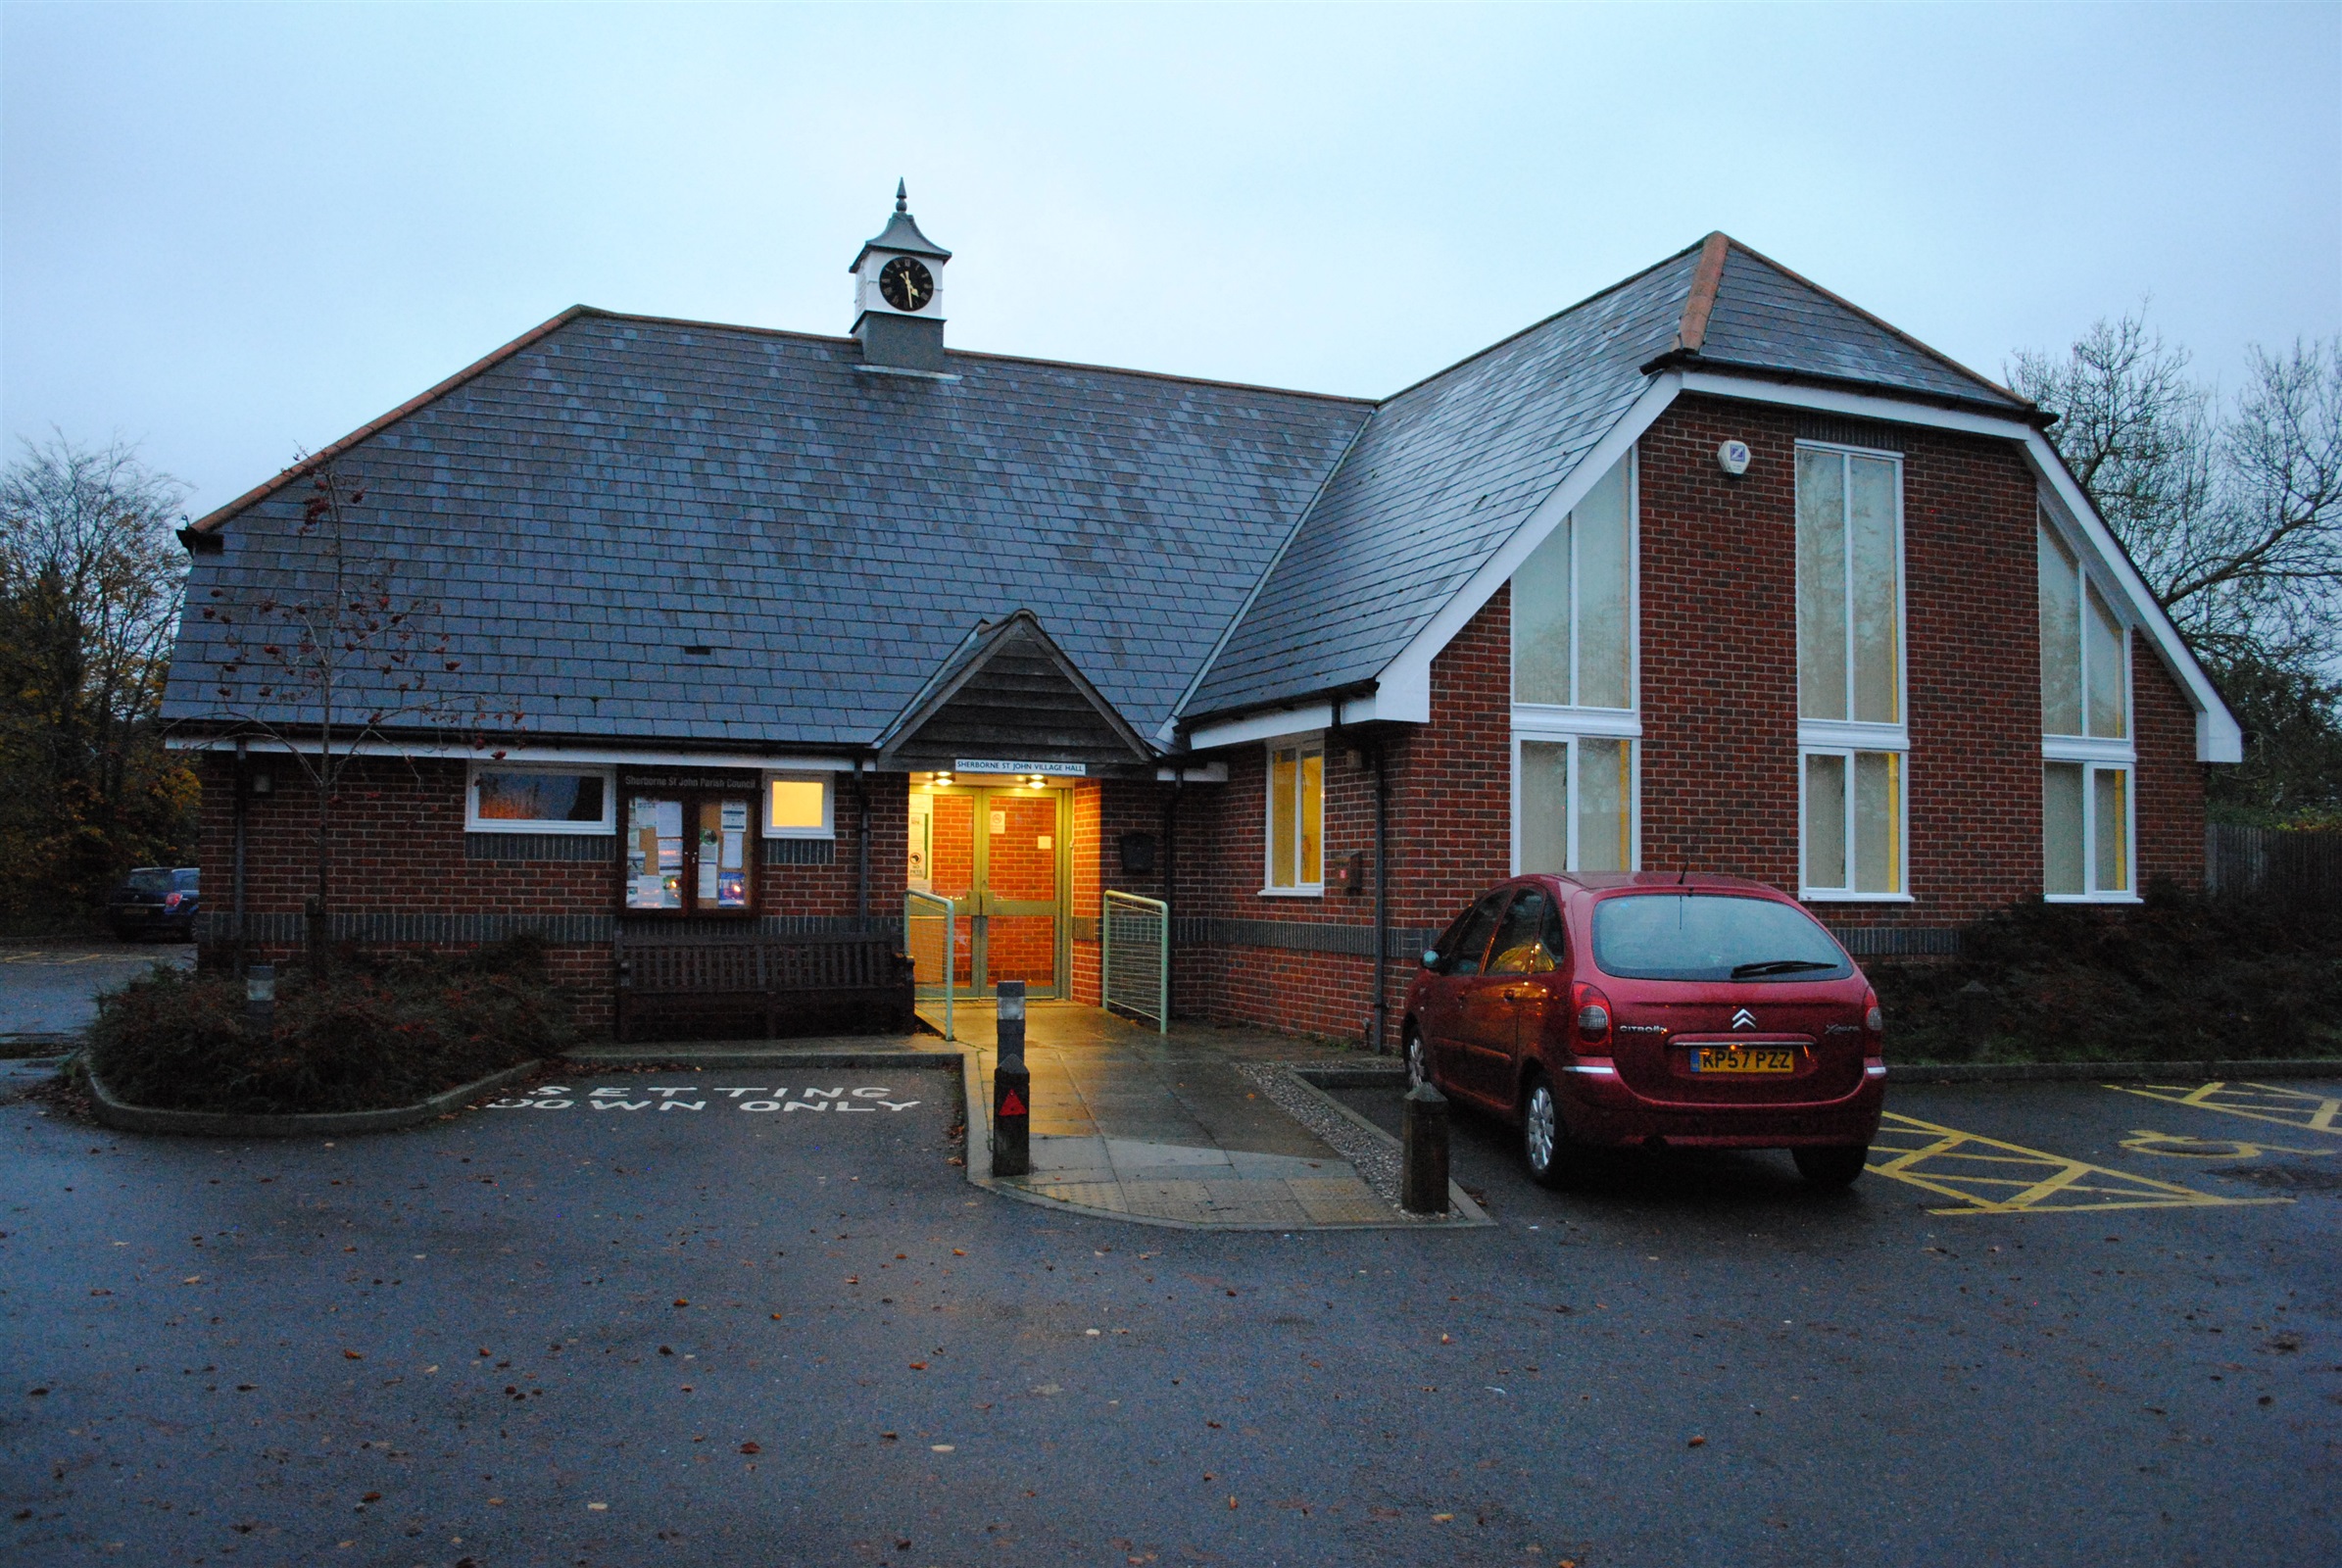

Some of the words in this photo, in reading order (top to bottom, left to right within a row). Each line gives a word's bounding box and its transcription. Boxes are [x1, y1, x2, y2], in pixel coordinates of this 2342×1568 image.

[956, 760, 1000, 769] SHERBORNE
[1012, 762, 1032, 771] JOHN
[625, 775, 667, 786] Sherborne
[668, 777, 676, 787] St
[678, 777, 699, 787] John
[700, 778, 725, 788] Parish
[726, 779, 756, 789] Council
[1701, 1050, 1750, 1069] KP57
[1755, 1050, 1791, 1069] PZZ
[527, 1085, 892, 1099] SETTING
[485, 1098, 707, 1111] DOWN
[738, 1100, 922, 1112] ONLY
